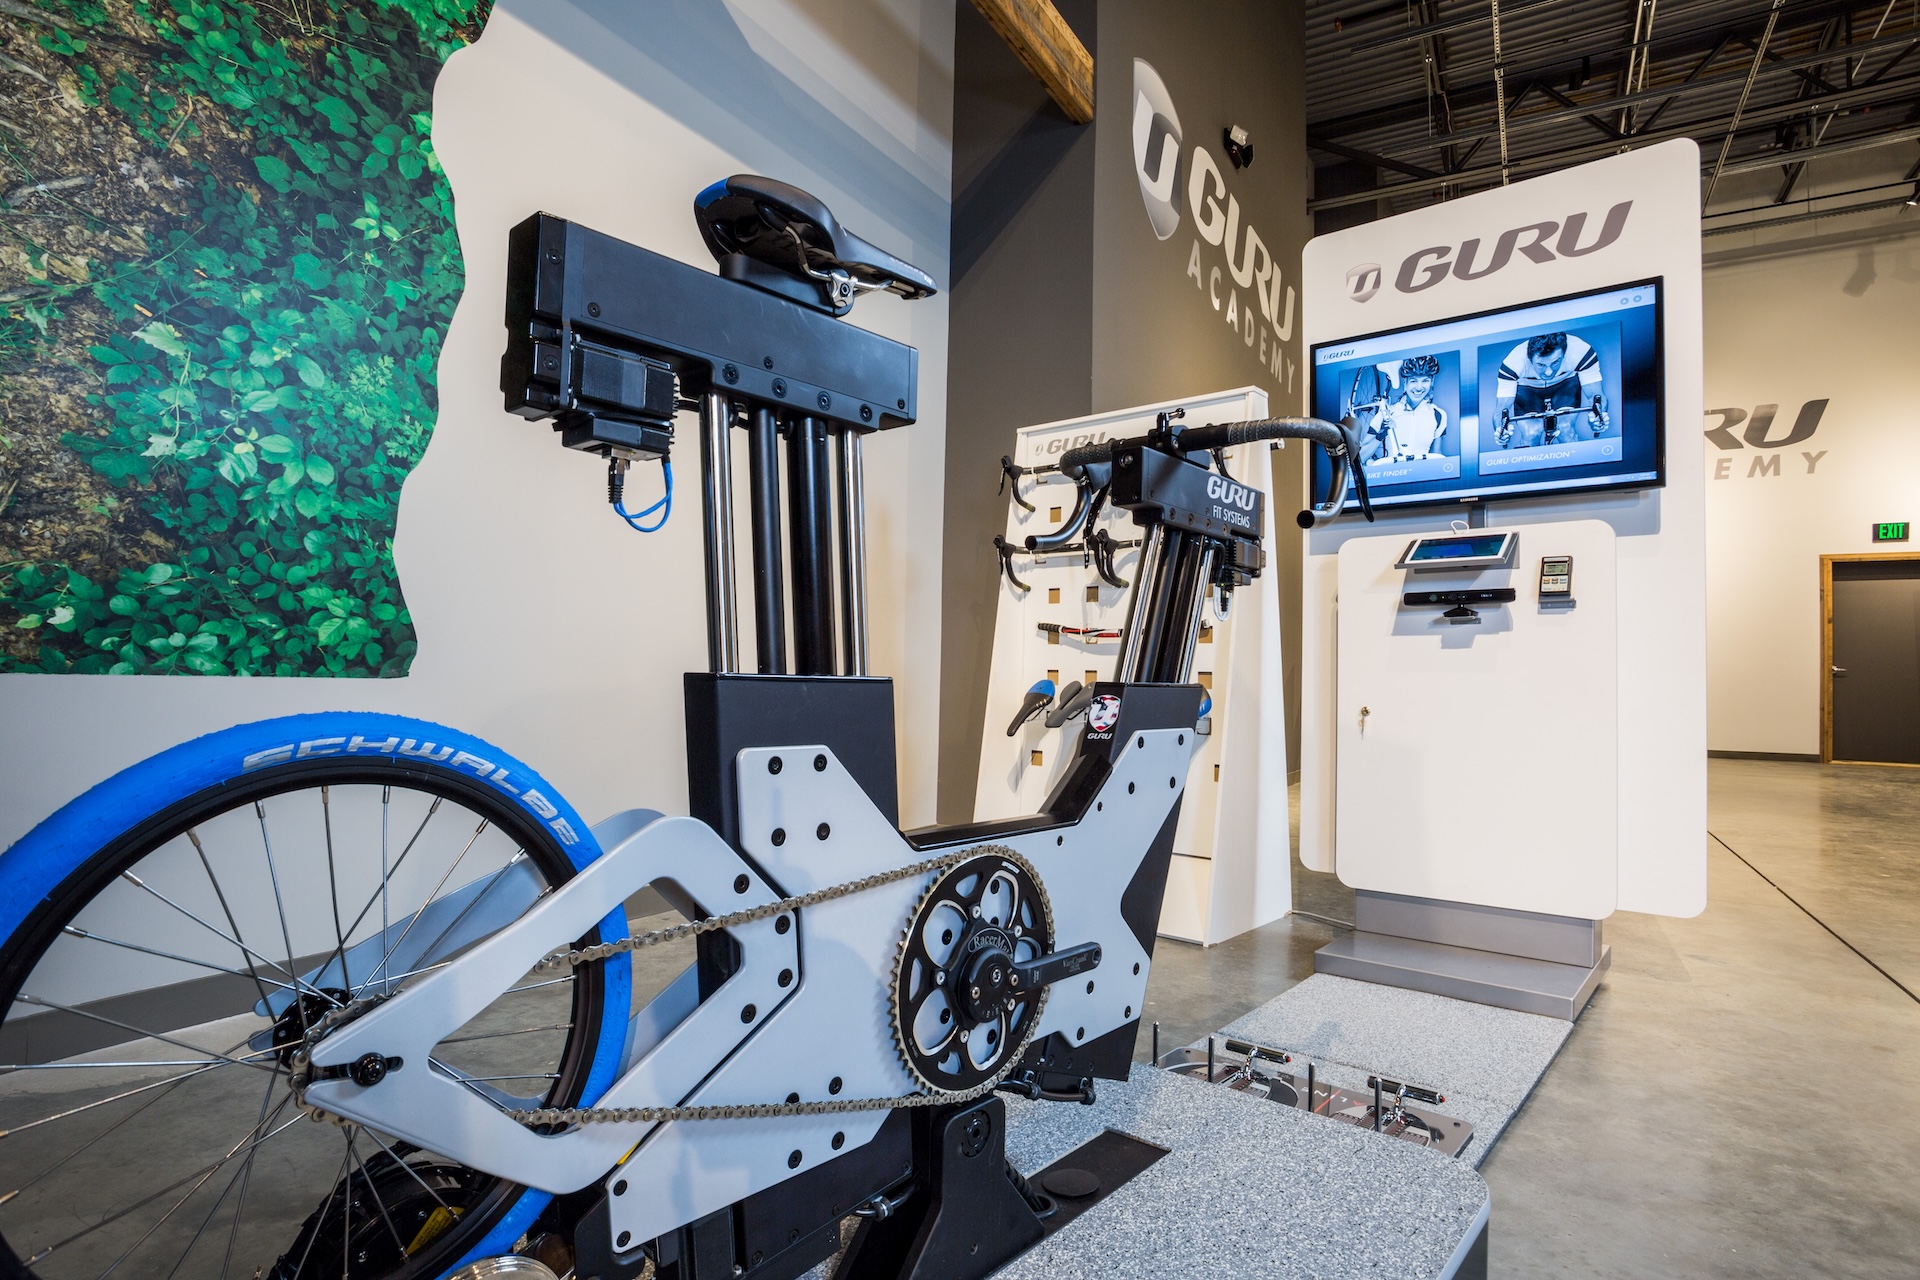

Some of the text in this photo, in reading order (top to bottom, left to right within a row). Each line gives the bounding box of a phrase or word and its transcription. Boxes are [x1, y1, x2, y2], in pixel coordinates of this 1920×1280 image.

[1188, 146, 1295, 341] GURU
[1394, 200, 1634, 293] GURU
[1187, 238, 1295, 394] ACADEMY
[1704, 398, 1830, 450] RU
[1486, 458, 1509, 466] GURU
[1207, 475, 1256, 511] GURU
[1212, 505, 1250, 528] FIT SYSTEMS
[1878, 522, 1905, 540] EXIT
[1087, 732, 1113, 740] GURU
[241, 735, 580, 847] SCHWALBE
